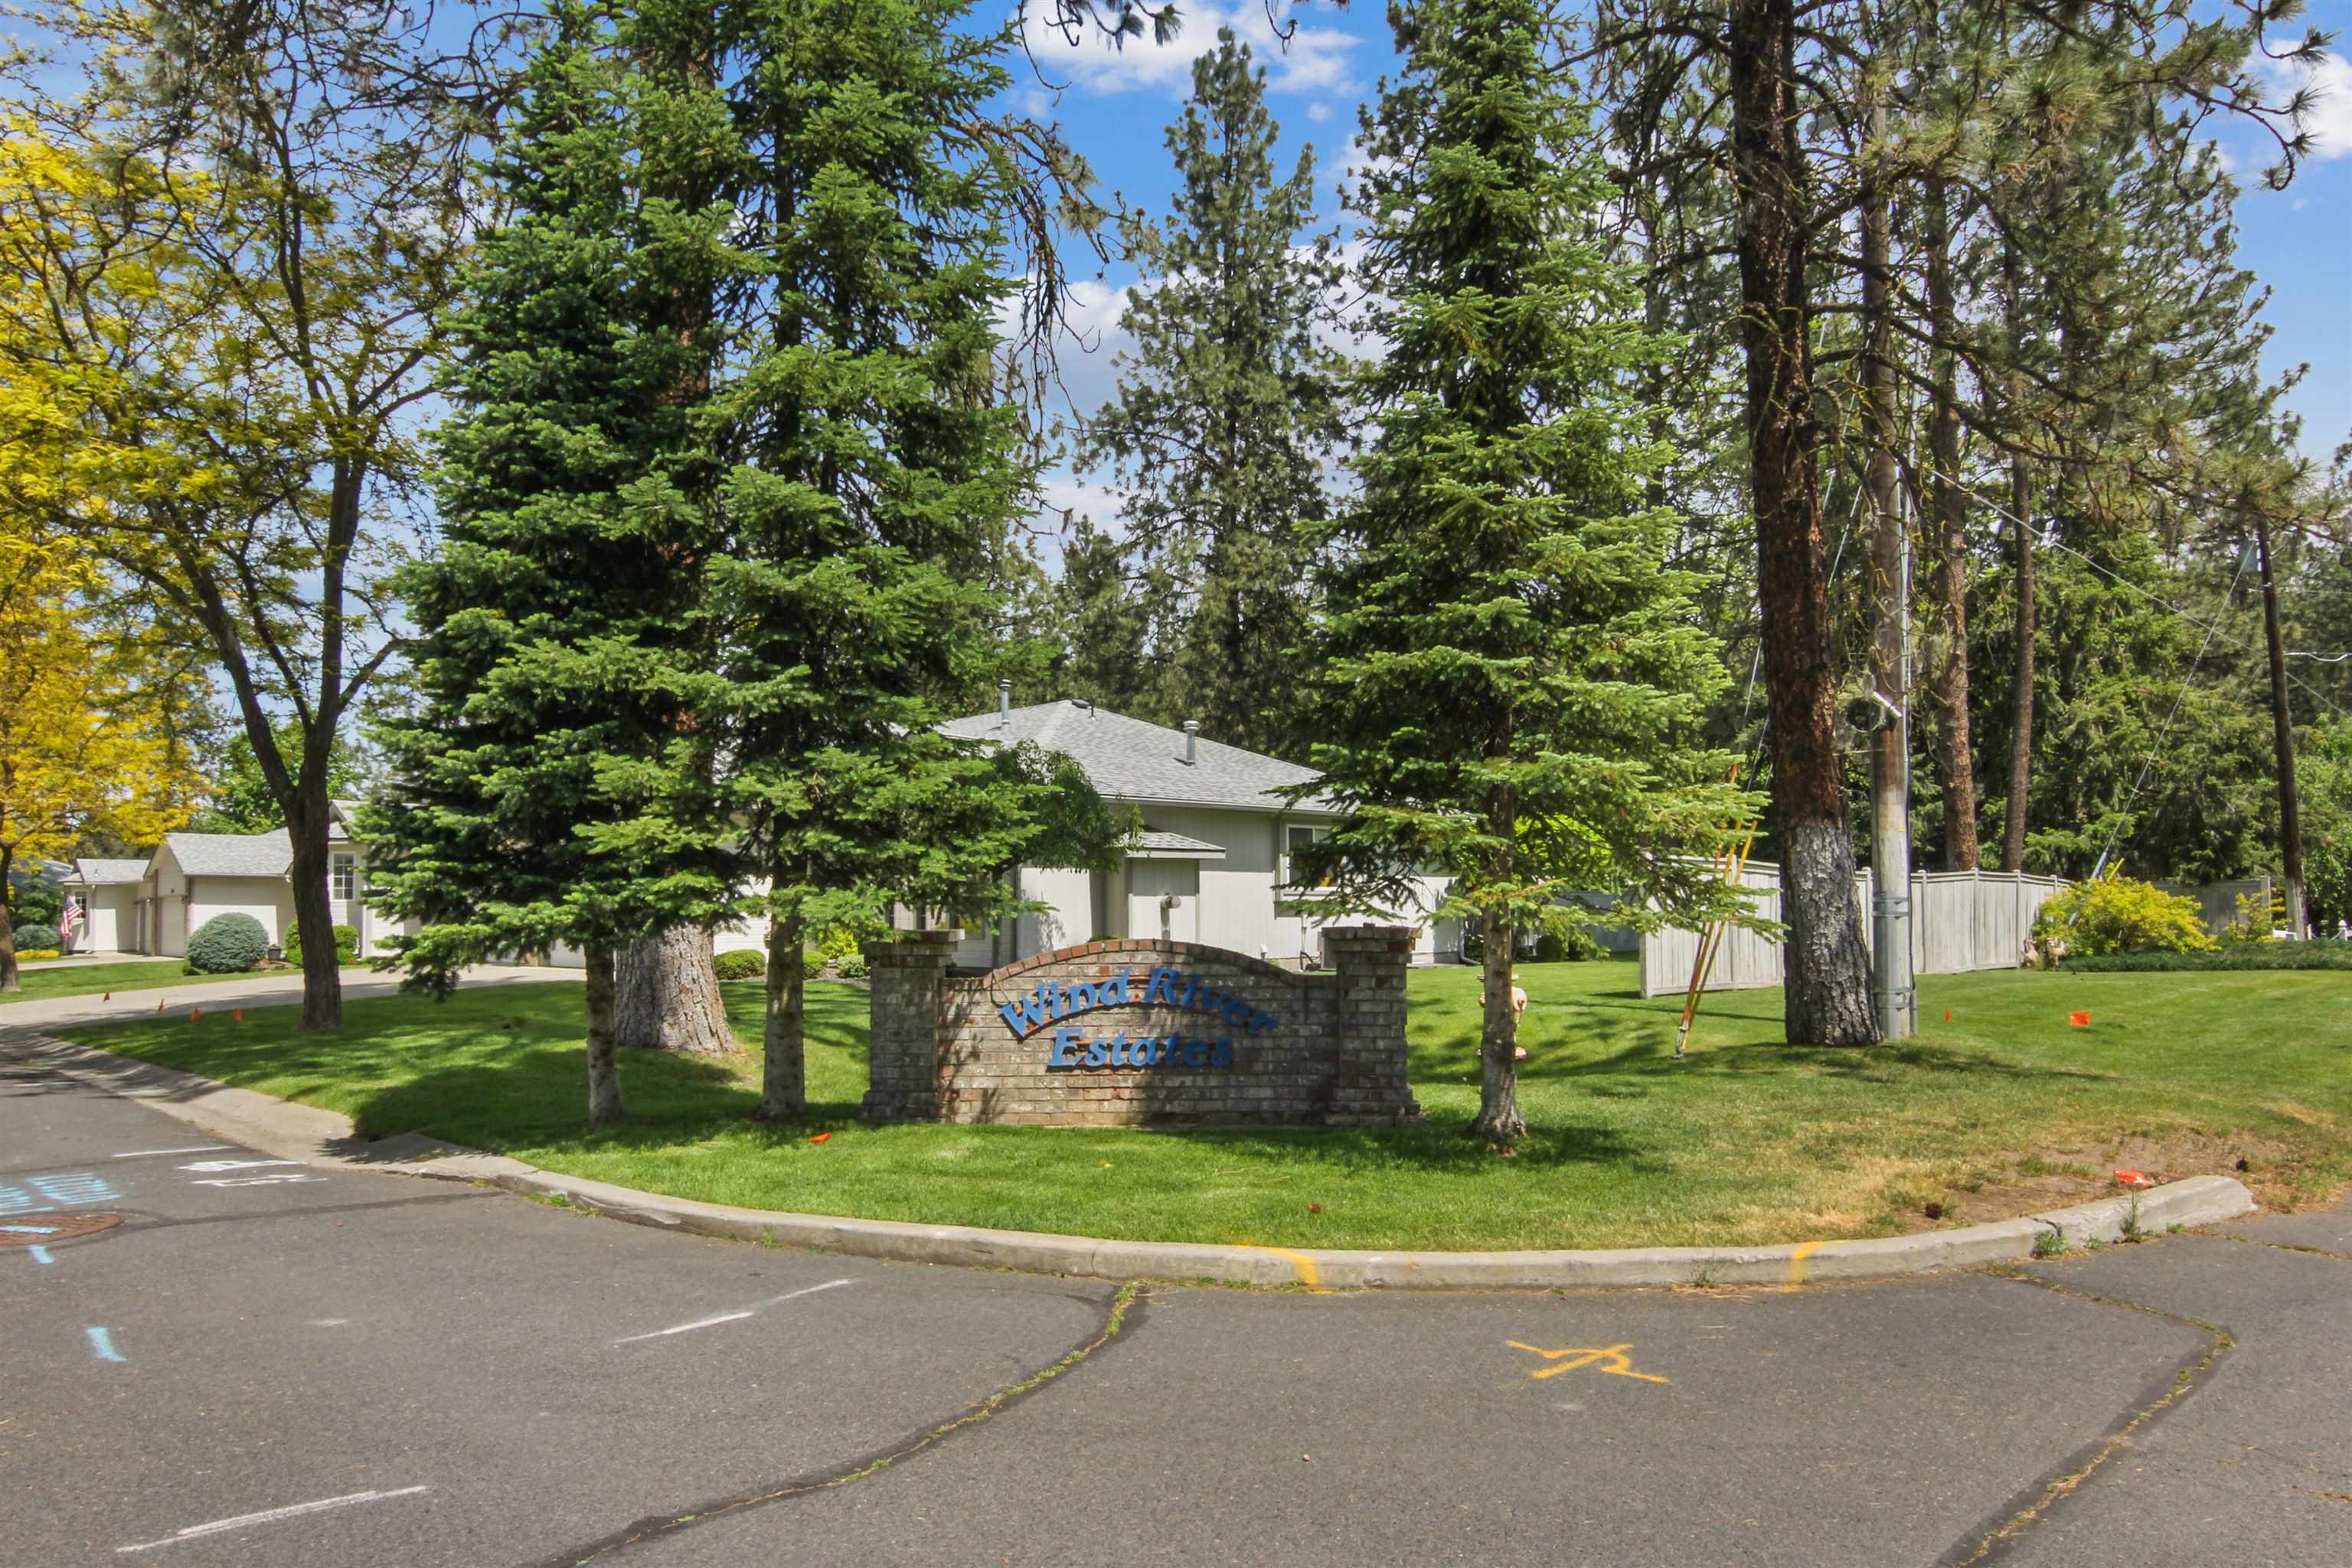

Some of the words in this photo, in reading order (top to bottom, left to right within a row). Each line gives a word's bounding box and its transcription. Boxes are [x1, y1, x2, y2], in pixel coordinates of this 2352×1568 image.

[998, 965, 1133, 1039] Wind
[1143, 966, 1277, 1035] River
[1048, 1027, 1236, 1067] Estates
